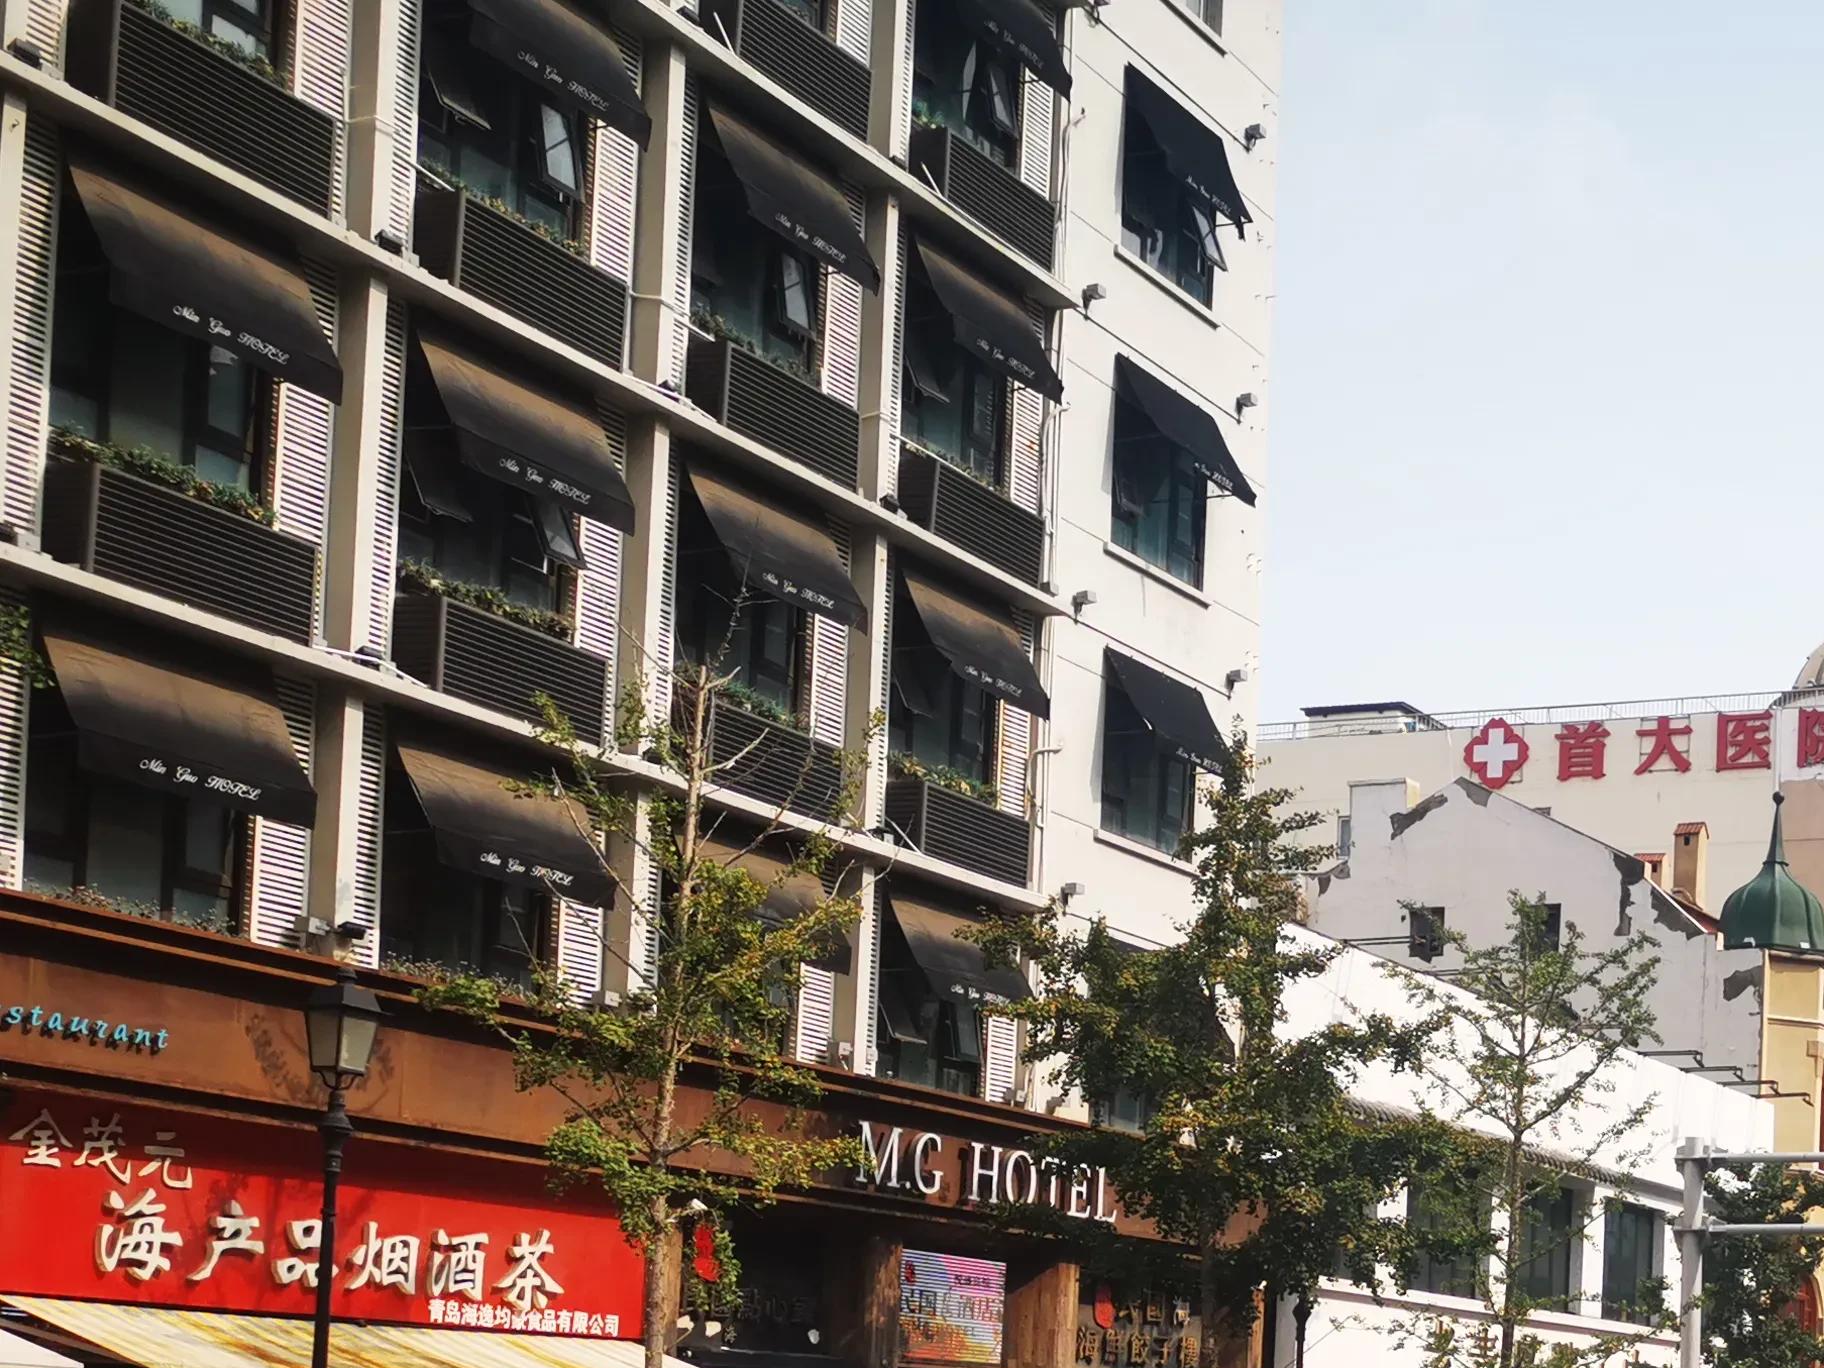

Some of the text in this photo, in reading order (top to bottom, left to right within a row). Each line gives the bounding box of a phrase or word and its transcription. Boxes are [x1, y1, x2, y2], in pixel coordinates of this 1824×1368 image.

[237, 331, 290, 365] HOTEL
[549, 478, 591, 505] HOTEL
[204, 775, 262, 801] HOTEL
[0, 1004, 169, 1049] staurant
[8, 1109, 193, 1190] 金茂元
[855, 1120, 1118, 1224] M.G HOTEL
[95, 1187, 564, 1311] 海产品烟酒茶
